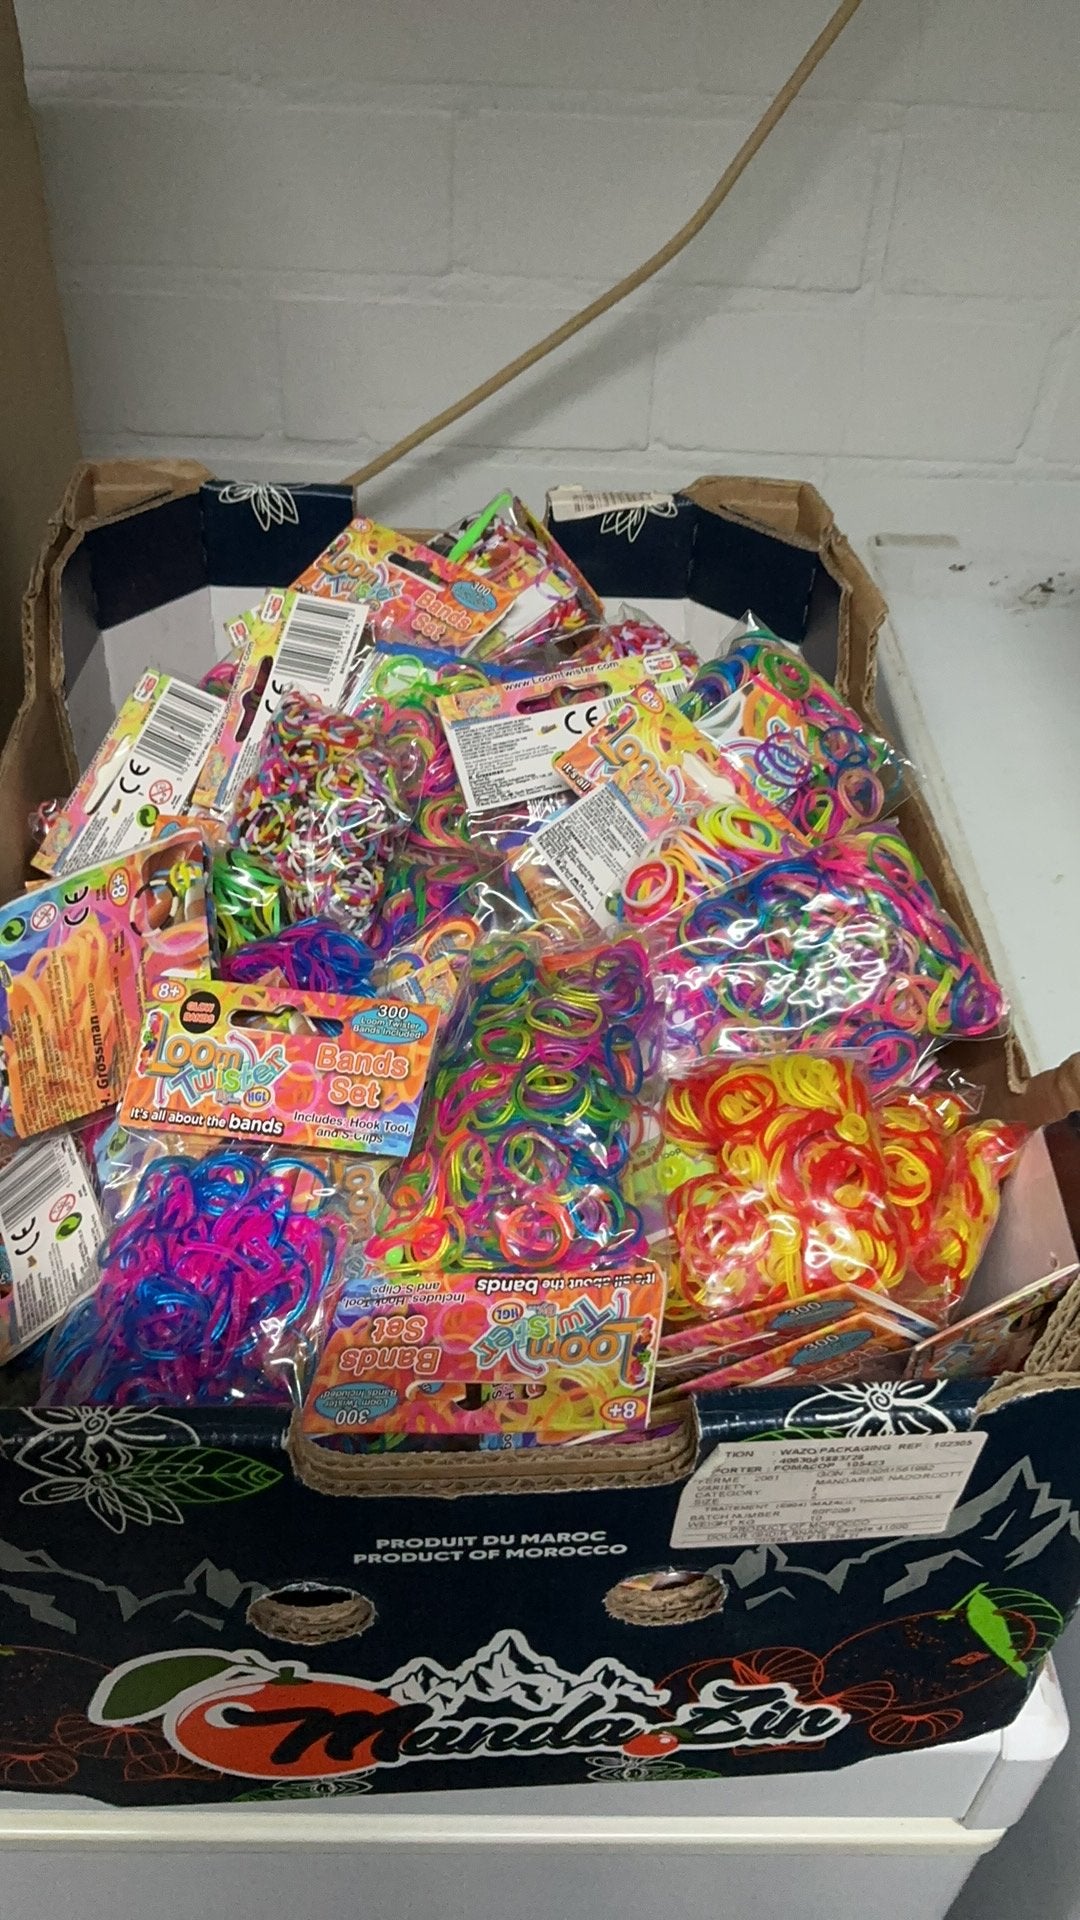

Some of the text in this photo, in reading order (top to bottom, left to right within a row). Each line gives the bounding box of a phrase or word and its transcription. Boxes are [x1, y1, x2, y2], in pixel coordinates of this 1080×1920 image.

[472, 582, 491, 596] 300
[415, 589, 472, 632] Bands
[411, 613, 447, 641] Set
[641, 690, 662, 709] 8+
[562, 763, 592, 792] It's all
[112, 874, 127, 898] 8+
[158, 983, 180, 998] 8+
[186, 1001, 215, 1013] GLOW
[377, 1005, 409, 1019] 300
[183, 1013, 216, 1024] BANDS
[361, 1017, 420, 1029] Loom Twister
[353, 1025, 381, 1034] Bands
[91, 1015, 108, 1089] Grossman
[143, 1012, 244, 1077] Loom
[315, 1042, 410, 1079] Bands
[168, 1046, 287, 1104] Twister
[247, 1091, 267, 1102] HGL
[328, 1075, 381, 1108] Set
[130, 1107, 284, 1135] It's all about the bands
[350, 1118, 380, 1130] Hook
[385, 1121, 411, 1135] Tool,
[316, 1127, 337, 1137] and
[417, 1282, 440, 1291] and
[477, 1277, 538, 1295] bands
[542, 1277, 565, 1290] the
[569, 1276, 611, 1290] about
[375, 1295, 406, 1307] Hook
[496, 1307, 519, 1320] HGL
[785, 1301, 822, 1320] 300
[372, 1315, 427, 1343] Set
[476, 1298, 615, 1366] Twister
[527, 1317, 652, 1384] Loom
[803, 1333, 840, 1352] 300
[340, 1347, 441, 1376] Bands
[335, 1409, 370, 1425] 300
[609, 1402, 637, 1418] 8+
[780, 1448, 817, 1456] WAZO
[820, 1444, 891, 1454] PACKAGING
[898, 1442, 922, 1450] REF
[697, 1471, 964, 1492] VARIETY MANDARINE NADORCOTT
[695, 1490, 762, 1499] CATEGORY
[689, 1513, 729, 1521] BATCH
[732, 1511, 780, 1519] NUMBER
[376, 1530, 607, 1549] PRODUIT DU MAROC
[353, 1544, 628, 1564] PRODUCT OF MOROCCO
[678, 1682, 842, 1745] Zin
